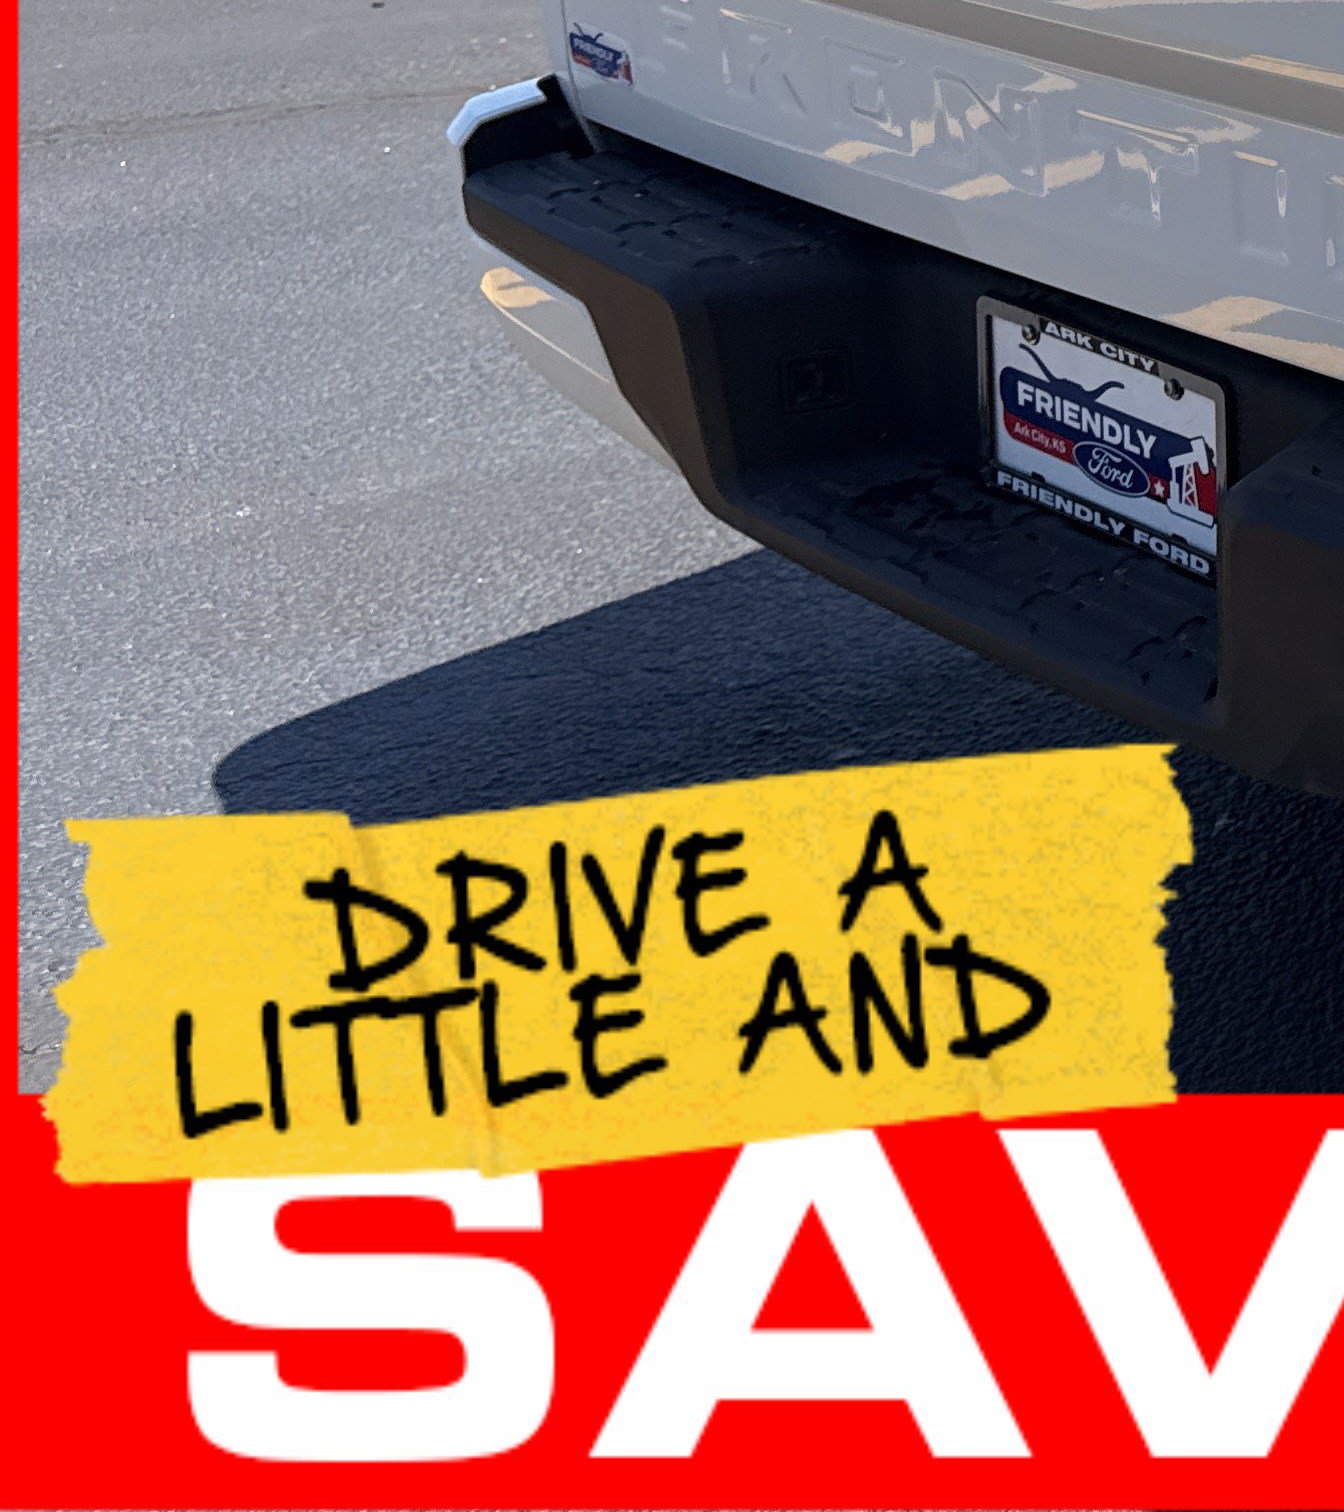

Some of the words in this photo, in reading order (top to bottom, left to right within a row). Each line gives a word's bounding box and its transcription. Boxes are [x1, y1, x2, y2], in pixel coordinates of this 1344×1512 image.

[1043, 321, 1093, 350] ARK
[1099, 340, 1157, 372] CITY
[1016, 380, 1157, 460] FRIENDLY
[1087, 444, 1134, 490] Ford
[997, 470, 1127, 538] FRIENDLY
[1133, 529, 1211, 577] FORD
